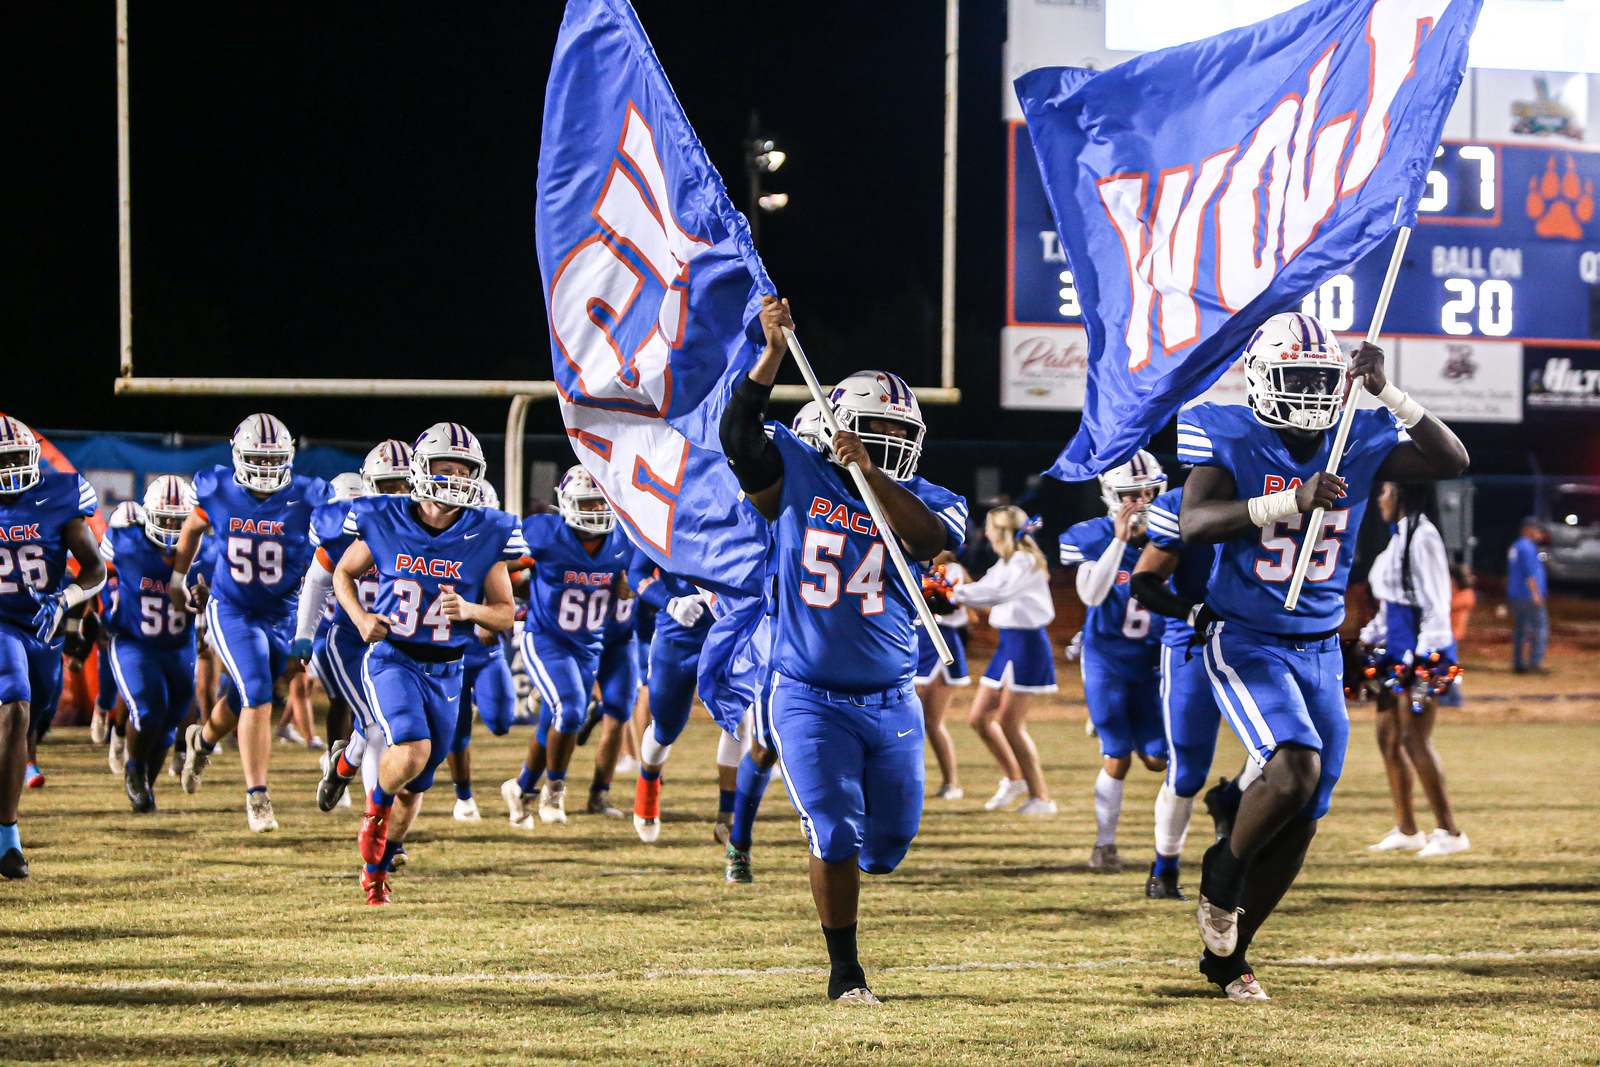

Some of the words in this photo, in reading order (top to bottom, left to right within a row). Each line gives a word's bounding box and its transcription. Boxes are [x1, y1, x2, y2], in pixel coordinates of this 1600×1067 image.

[1096, 0, 1452, 373] WOLF
[1432, 245, 1486, 277] BALL
[1489, 247, 1523, 278] ON
[1441, 279, 1513, 336] 20
[229, 517, 285, 535] PACK
[1253, 507, 1350, 583] 55
[228, 536, 283, 584] 59
[395, 553, 463, 579] PACK
[564, 570, 614, 586] PACK
[799, 527, 886, 616] 54
[390, 577, 456, 642] 34
[558, 588, 611, 632] 60
